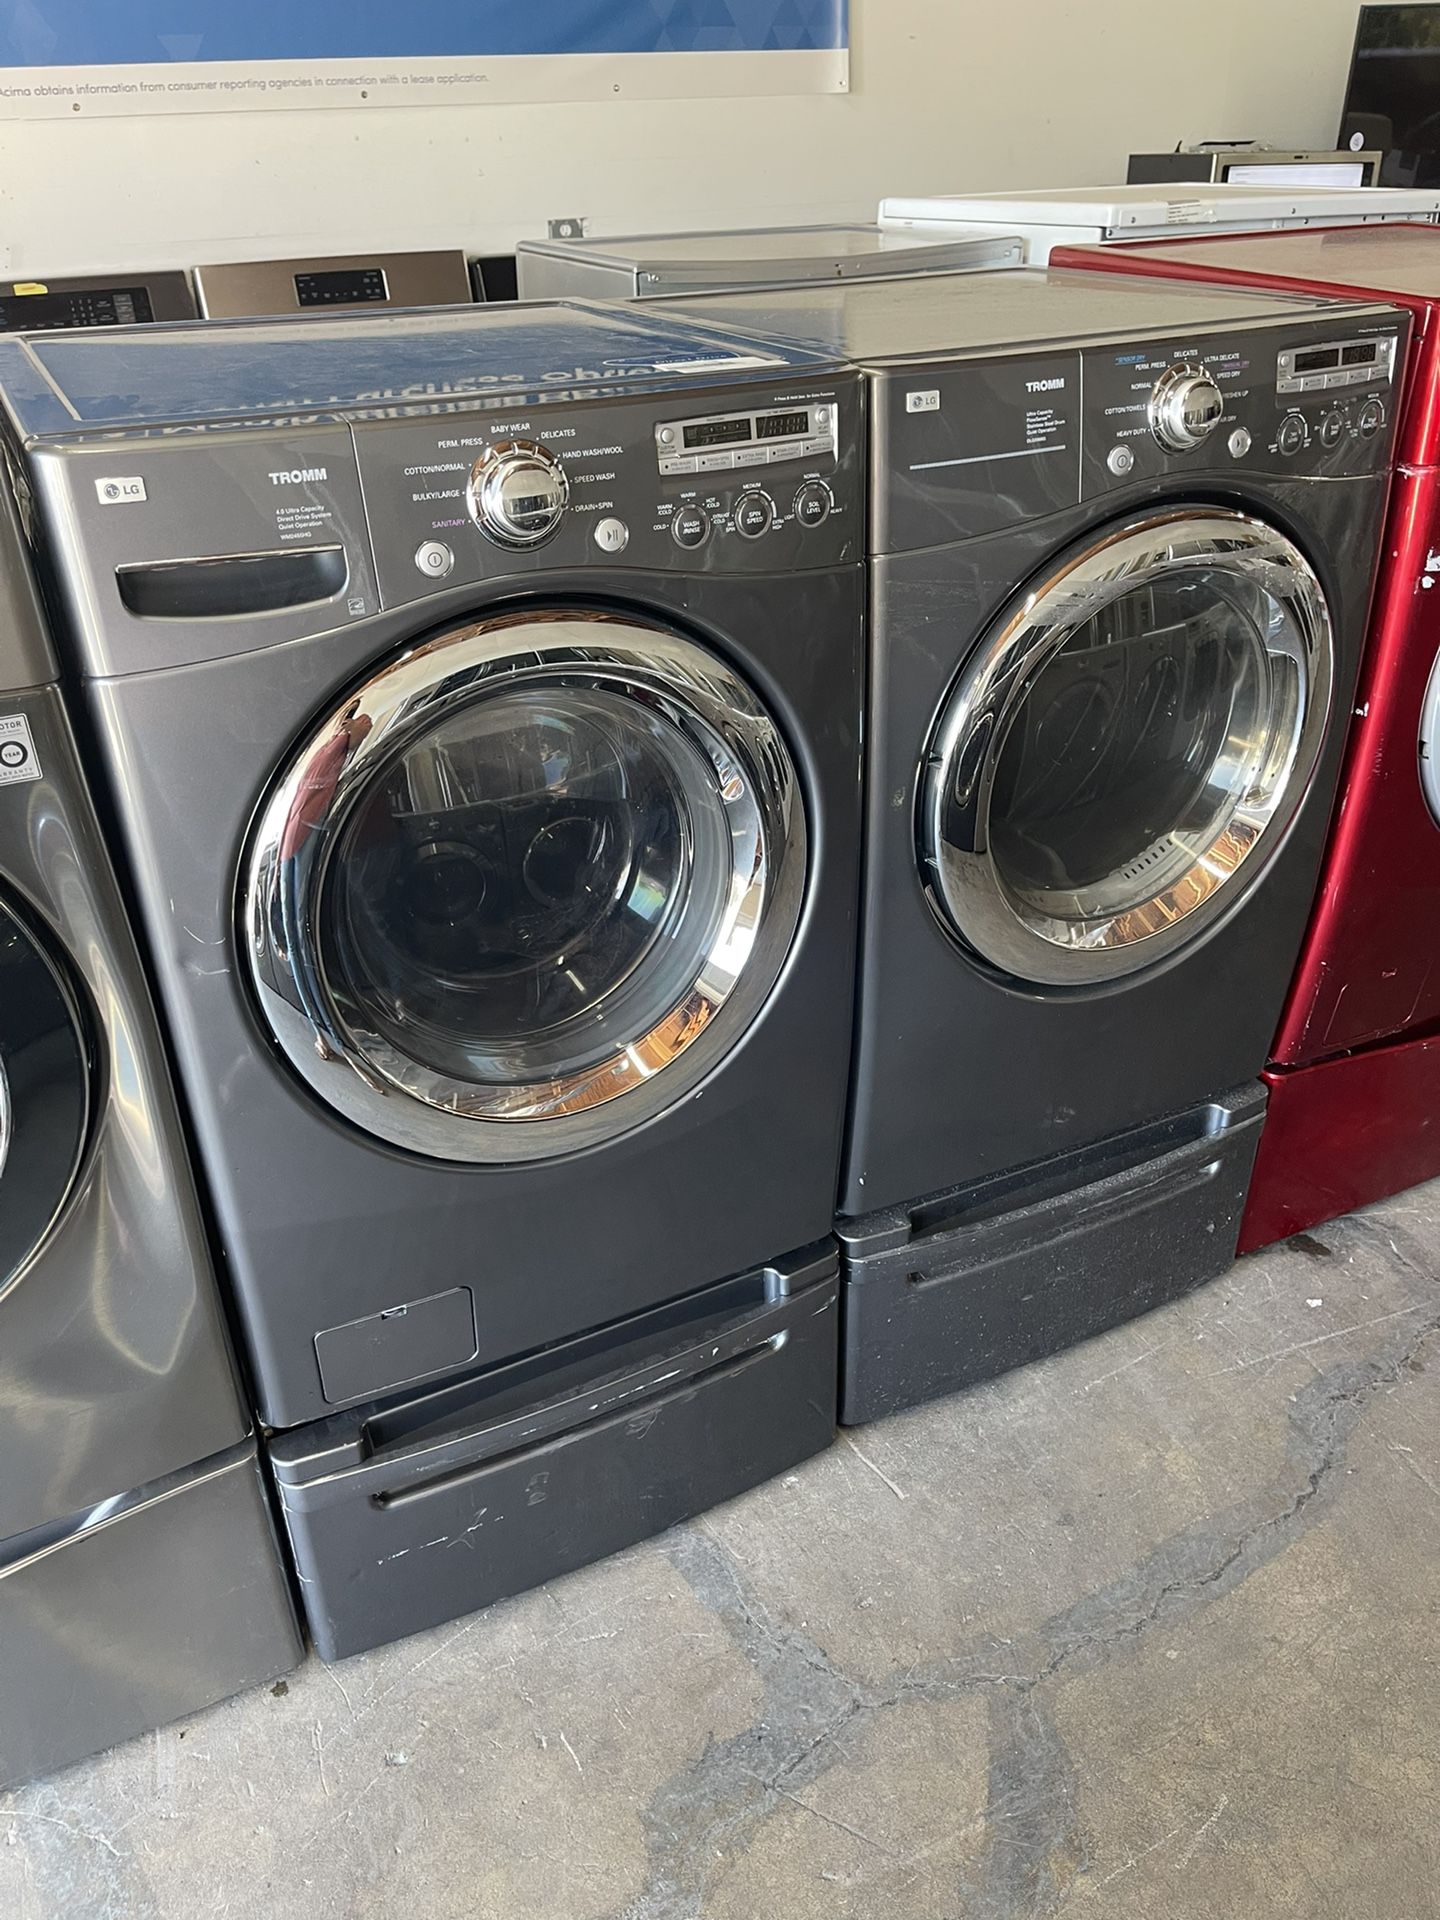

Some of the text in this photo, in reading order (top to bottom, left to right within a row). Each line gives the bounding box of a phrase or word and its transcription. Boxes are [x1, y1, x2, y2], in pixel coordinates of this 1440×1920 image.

[34, 84, 74, 96] obtains
[76, 83, 138, 95] information
[140, 82, 166, 92] from
[167, 80, 217, 91] consumer
[220, 78, 266, 91] reporting
[268, 76, 312, 90] agencies
[314, 76, 323, 86] in
[325, 75, 377, 86] connection
[380, 74, 400, 84] with
[401, 75, 408, 84] a
[410, 74, 434, 84] lease
[437, 73, 490, 85] application.
[1174, 349, 1198, 358] DELICATES
[1204, 353, 1240, 363] ULTRA DELICATE
[1152, 361, 1166, 369] PRESS
[1025, 378, 1064, 392] TROMM
[1131, 382, 1152, 390] NORMAL
[490, 422, 530, 433] BABY WEAR
[1116, 427, 1146, 437] HEAVY DUTY
[541, 429, 576, 439] DELICATES
[437, 437, 483, 448] PERM. PRESS
[562, 446, 623, 459] HAND WASH/WOOL
[404, 462, 466, 475] COTTON/NORMAL
[268, 468, 327, 485] TROMM
[574, 472, 616, 483] SPEED WASH
[123, 484, 140, 495] LG
[412, 489, 460, 501] BULKY/LARGE
[295, 520, 323, 529] Operation
[432, 519, 466, 528] SANITARY
[747, 516, 763, 524] SPEED
[0, 721, 22, 730] OTOR
